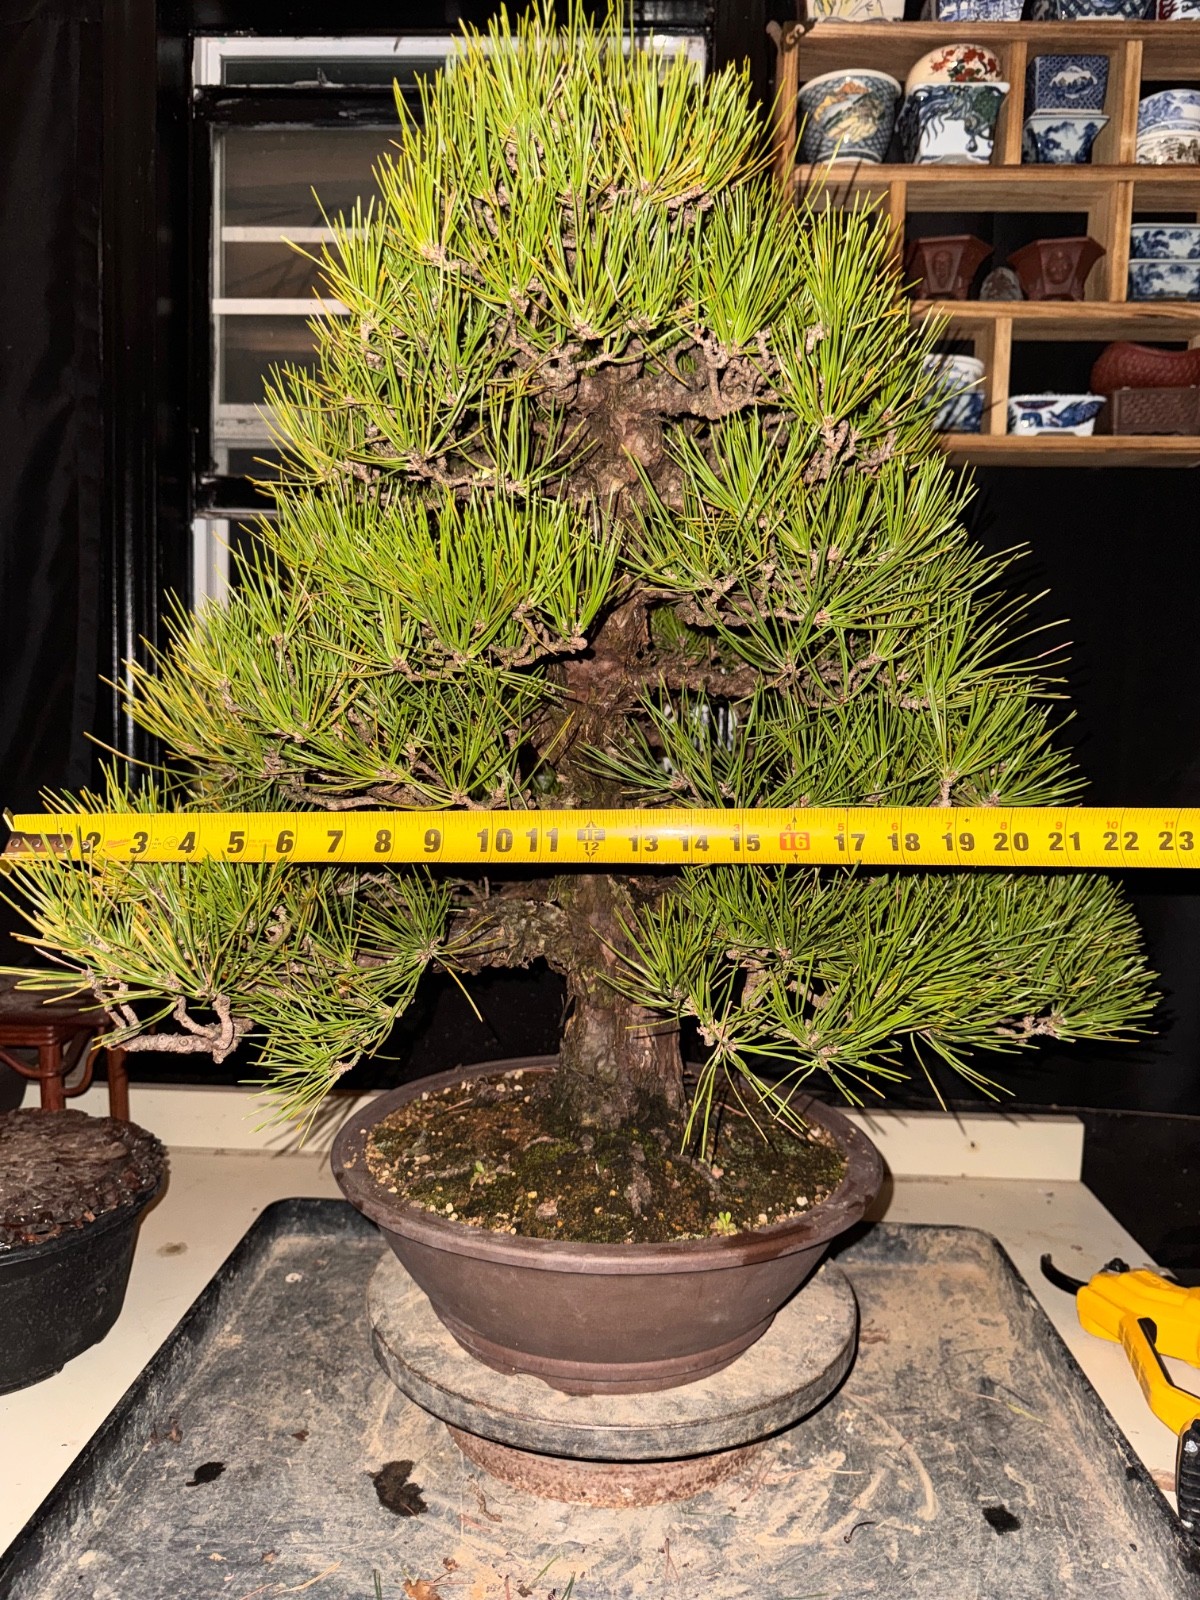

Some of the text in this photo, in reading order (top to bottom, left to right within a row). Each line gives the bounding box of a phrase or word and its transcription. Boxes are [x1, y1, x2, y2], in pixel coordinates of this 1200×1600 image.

[785, 823, 792, 831] 4
[837, 822, 845, 831] 5
[891, 822, 898, 831] 6
[945, 822, 953, 830] 7
[1000, 821, 1008, 830] 8
[1055, 821, 1063, 830] 9
[1106, 820, 1119, 829] 10
[1164, 821, 1174, 829] 11
[82, 832, 102, 853] 2
[129, 831, 149, 853] 3
[178, 831, 196, 853] 4
[227, 831, 245, 853] 5
[276, 830, 294, 853] 6
[327, 830, 343, 853] 7
[374, 829, 392, 853] 8
[424, 829, 441, 853] 9
[477, 828, 513, 852] 10
[526, 828, 558, 852] 11
[583, 842, 600, 850] 12
[628, 835, 659, 852] 13
[679, 834, 709, 851] 14
[730, 834, 760, 851] 15
[782, 833, 808, 849] 16
[834, 833, 865, 851] 17
[887, 833, 920, 851] 18
[942, 832, 975, 851] 19
[993, 832, 1029, 851] 20
[1048, 832, 1080, 851] 21
[1103, 831, 1139, 851] 22
[1158, 831, 1194, 850] 23
